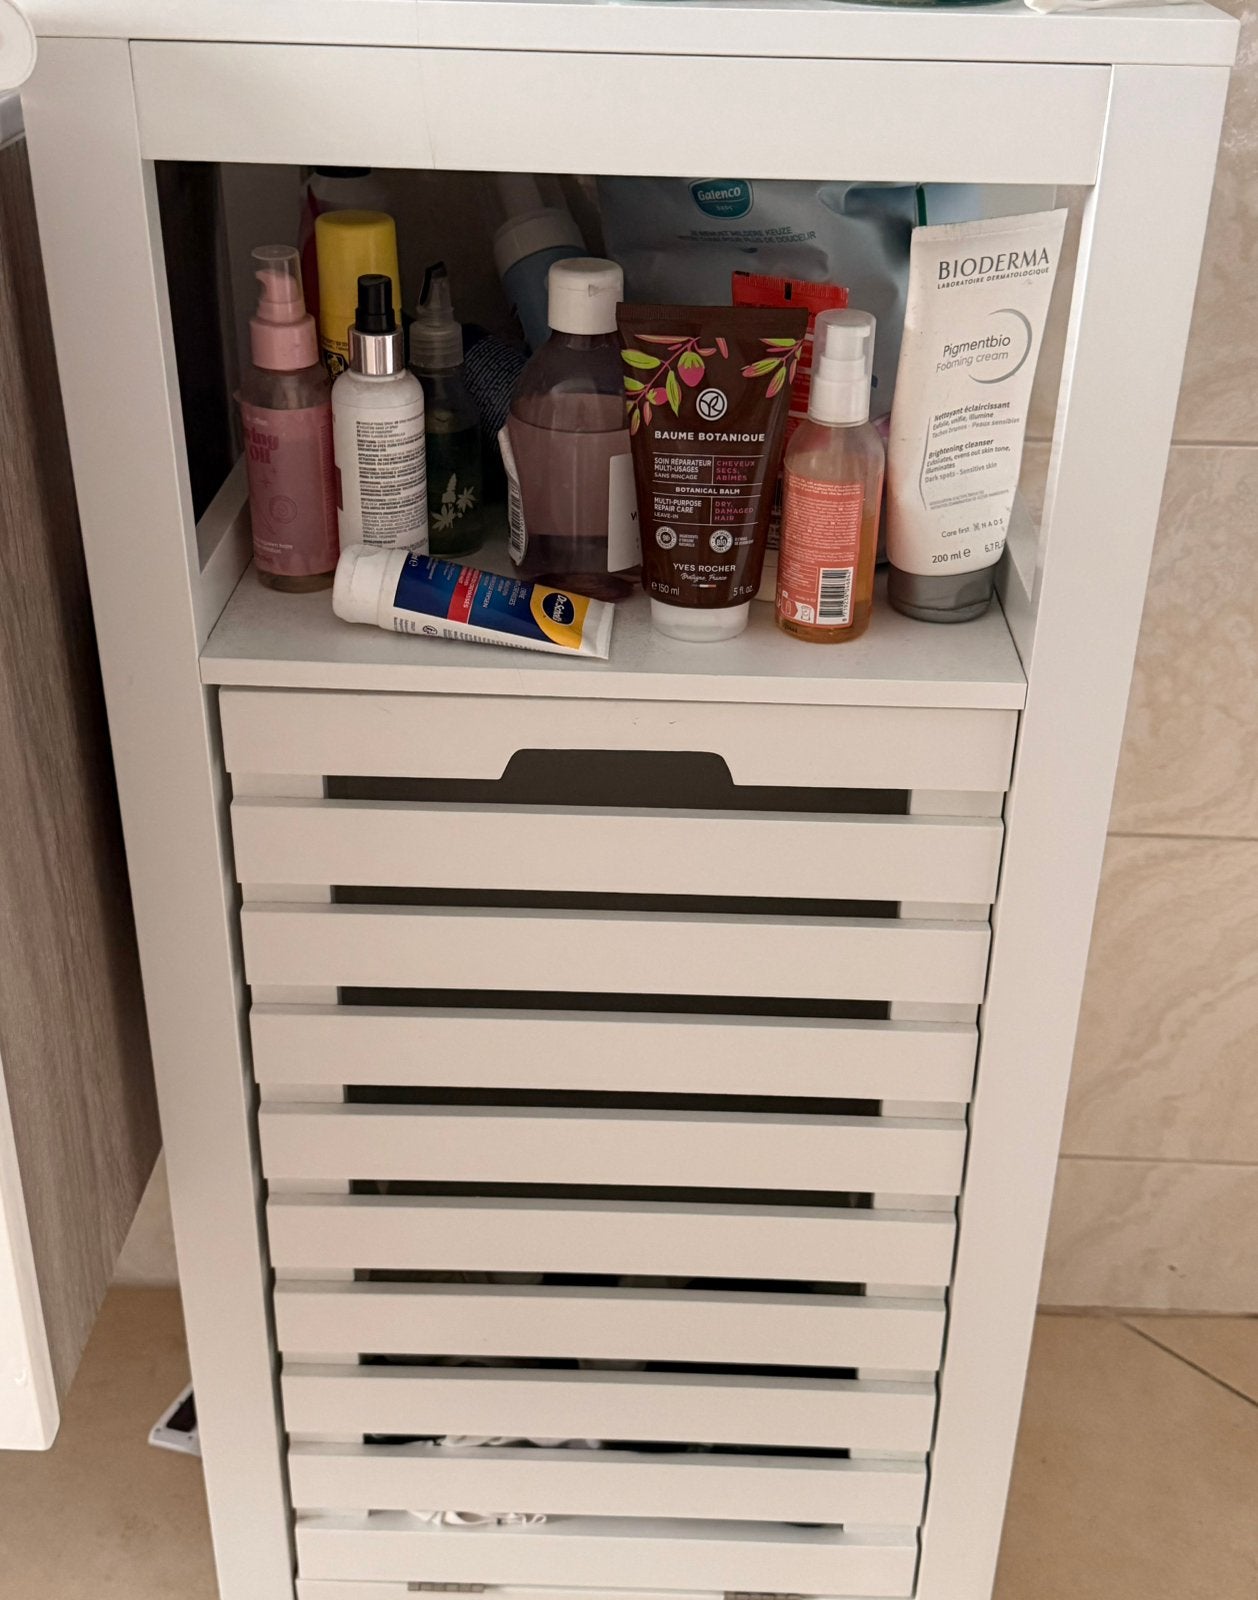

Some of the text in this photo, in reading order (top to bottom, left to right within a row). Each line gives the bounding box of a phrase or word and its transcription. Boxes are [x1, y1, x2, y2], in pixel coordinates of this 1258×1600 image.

[697, 186, 742, 201] Galenco
[766, 226, 793, 236] KEUZE
[776, 231, 817, 244] DOUCEUR
[938, 247, 1049, 280] BIODERMA
[937, 267, 1050, 290] LABORATOIRE DERMATOLOGIQUE
[942, 334, 1011, 358] Pigmentbio
[936, 352, 1009, 373] Foaming cream
[934, 402, 1010, 421] Nettoyant éclaircissant
[972, 420, 990, 428] Peaux
[991, 418, 1020, 426] sensibles
[654, 430, 765, 442] BAUME BOTANIQUE
[928, 440, 994, 459] Brightening cleanser
[954, 452, 970, 460] evens
[981, 446, 994, 454] skin
[654, 457, 670, 465] SOIN
[654, 465, 699, 473] MULTI-USAGES
[925, 474, 938, 483] Dark
[939, 472, 955, 481] spots
[959, 465, 985, 475] Sensitive
[986, 462, 998, 470] skin
[654, 497, 702, 507] MULTI-PURPOSE
[654, 503, 694, 514] REPAIR CARE
[941, 530, 957, 538] Care
[958, 526, 970, 535] first
[932, 553, 948, 564] 200
[950, 551, 961, 561] ml
[673, 562, 736, 573] YVES ROCHER
[658, 583, 669, 594] 150
[670, 586, 680, 596] ml
[733, 587, 738, 597] 5
